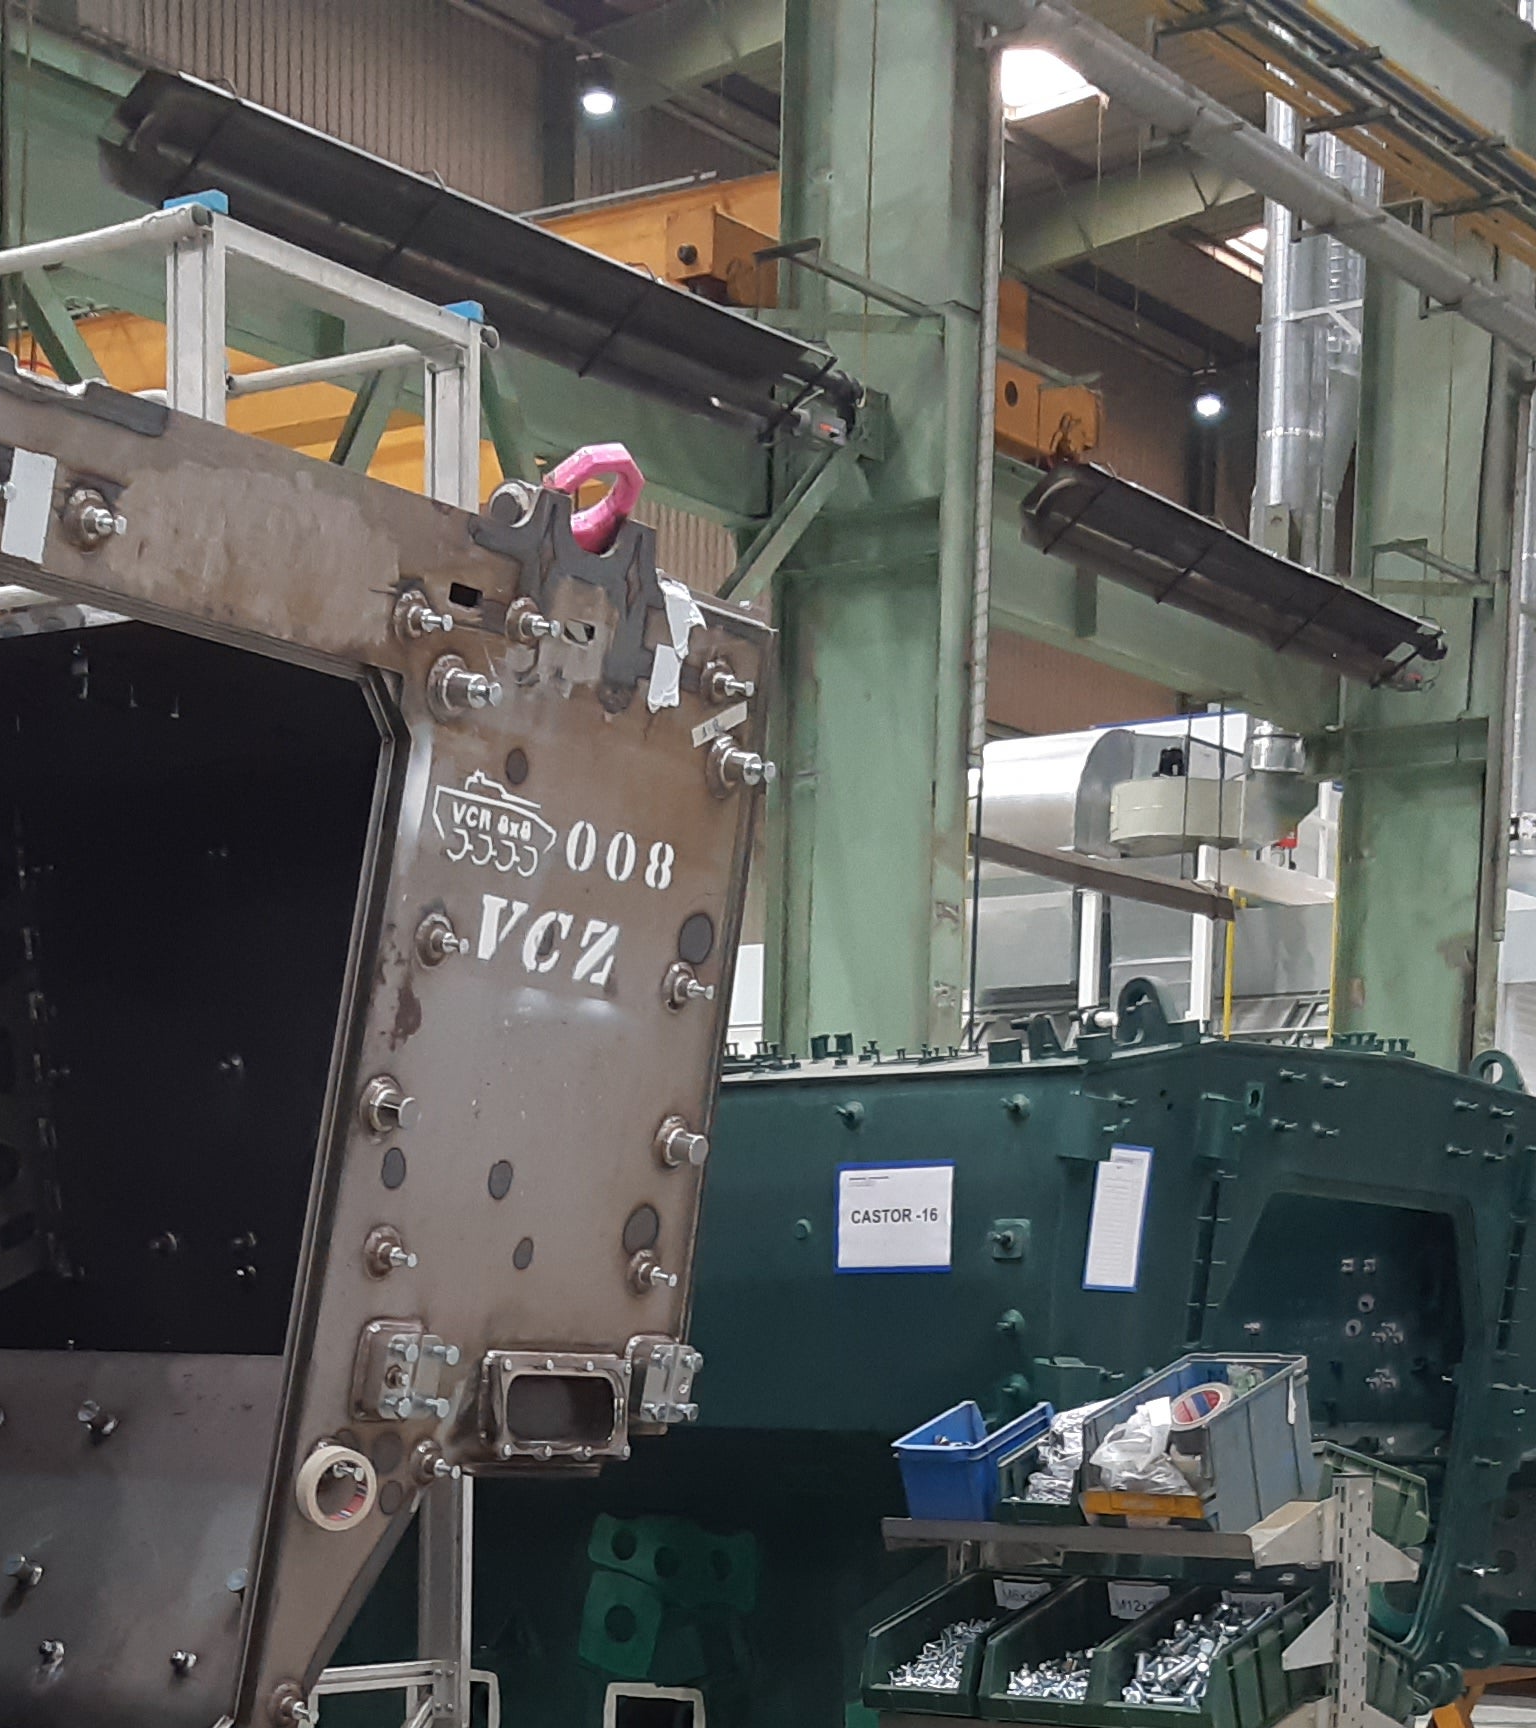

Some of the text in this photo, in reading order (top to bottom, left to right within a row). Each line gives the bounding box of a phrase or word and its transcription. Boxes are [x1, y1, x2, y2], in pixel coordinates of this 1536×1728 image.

[498, 814, 531, 841] 8x8
[566, 820, 675, 890] 008
[477, 894, 620, 986] VCZ
[851, 1207, 938, 1224] CASTOR -16
